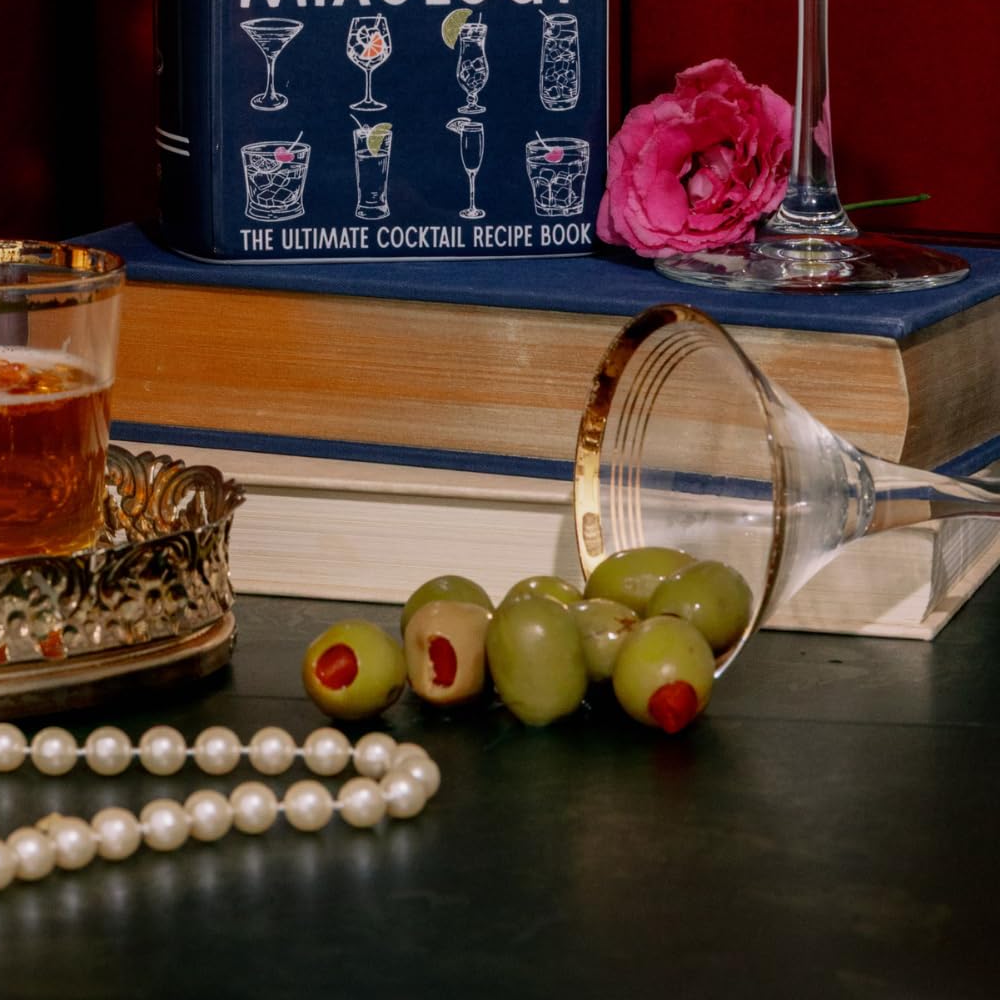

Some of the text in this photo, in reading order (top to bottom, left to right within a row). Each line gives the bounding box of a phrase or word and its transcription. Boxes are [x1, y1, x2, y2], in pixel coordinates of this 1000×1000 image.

[240, 223, 592, 251] THE ULTIMATE COCKTAIL RECIPE BOOK
